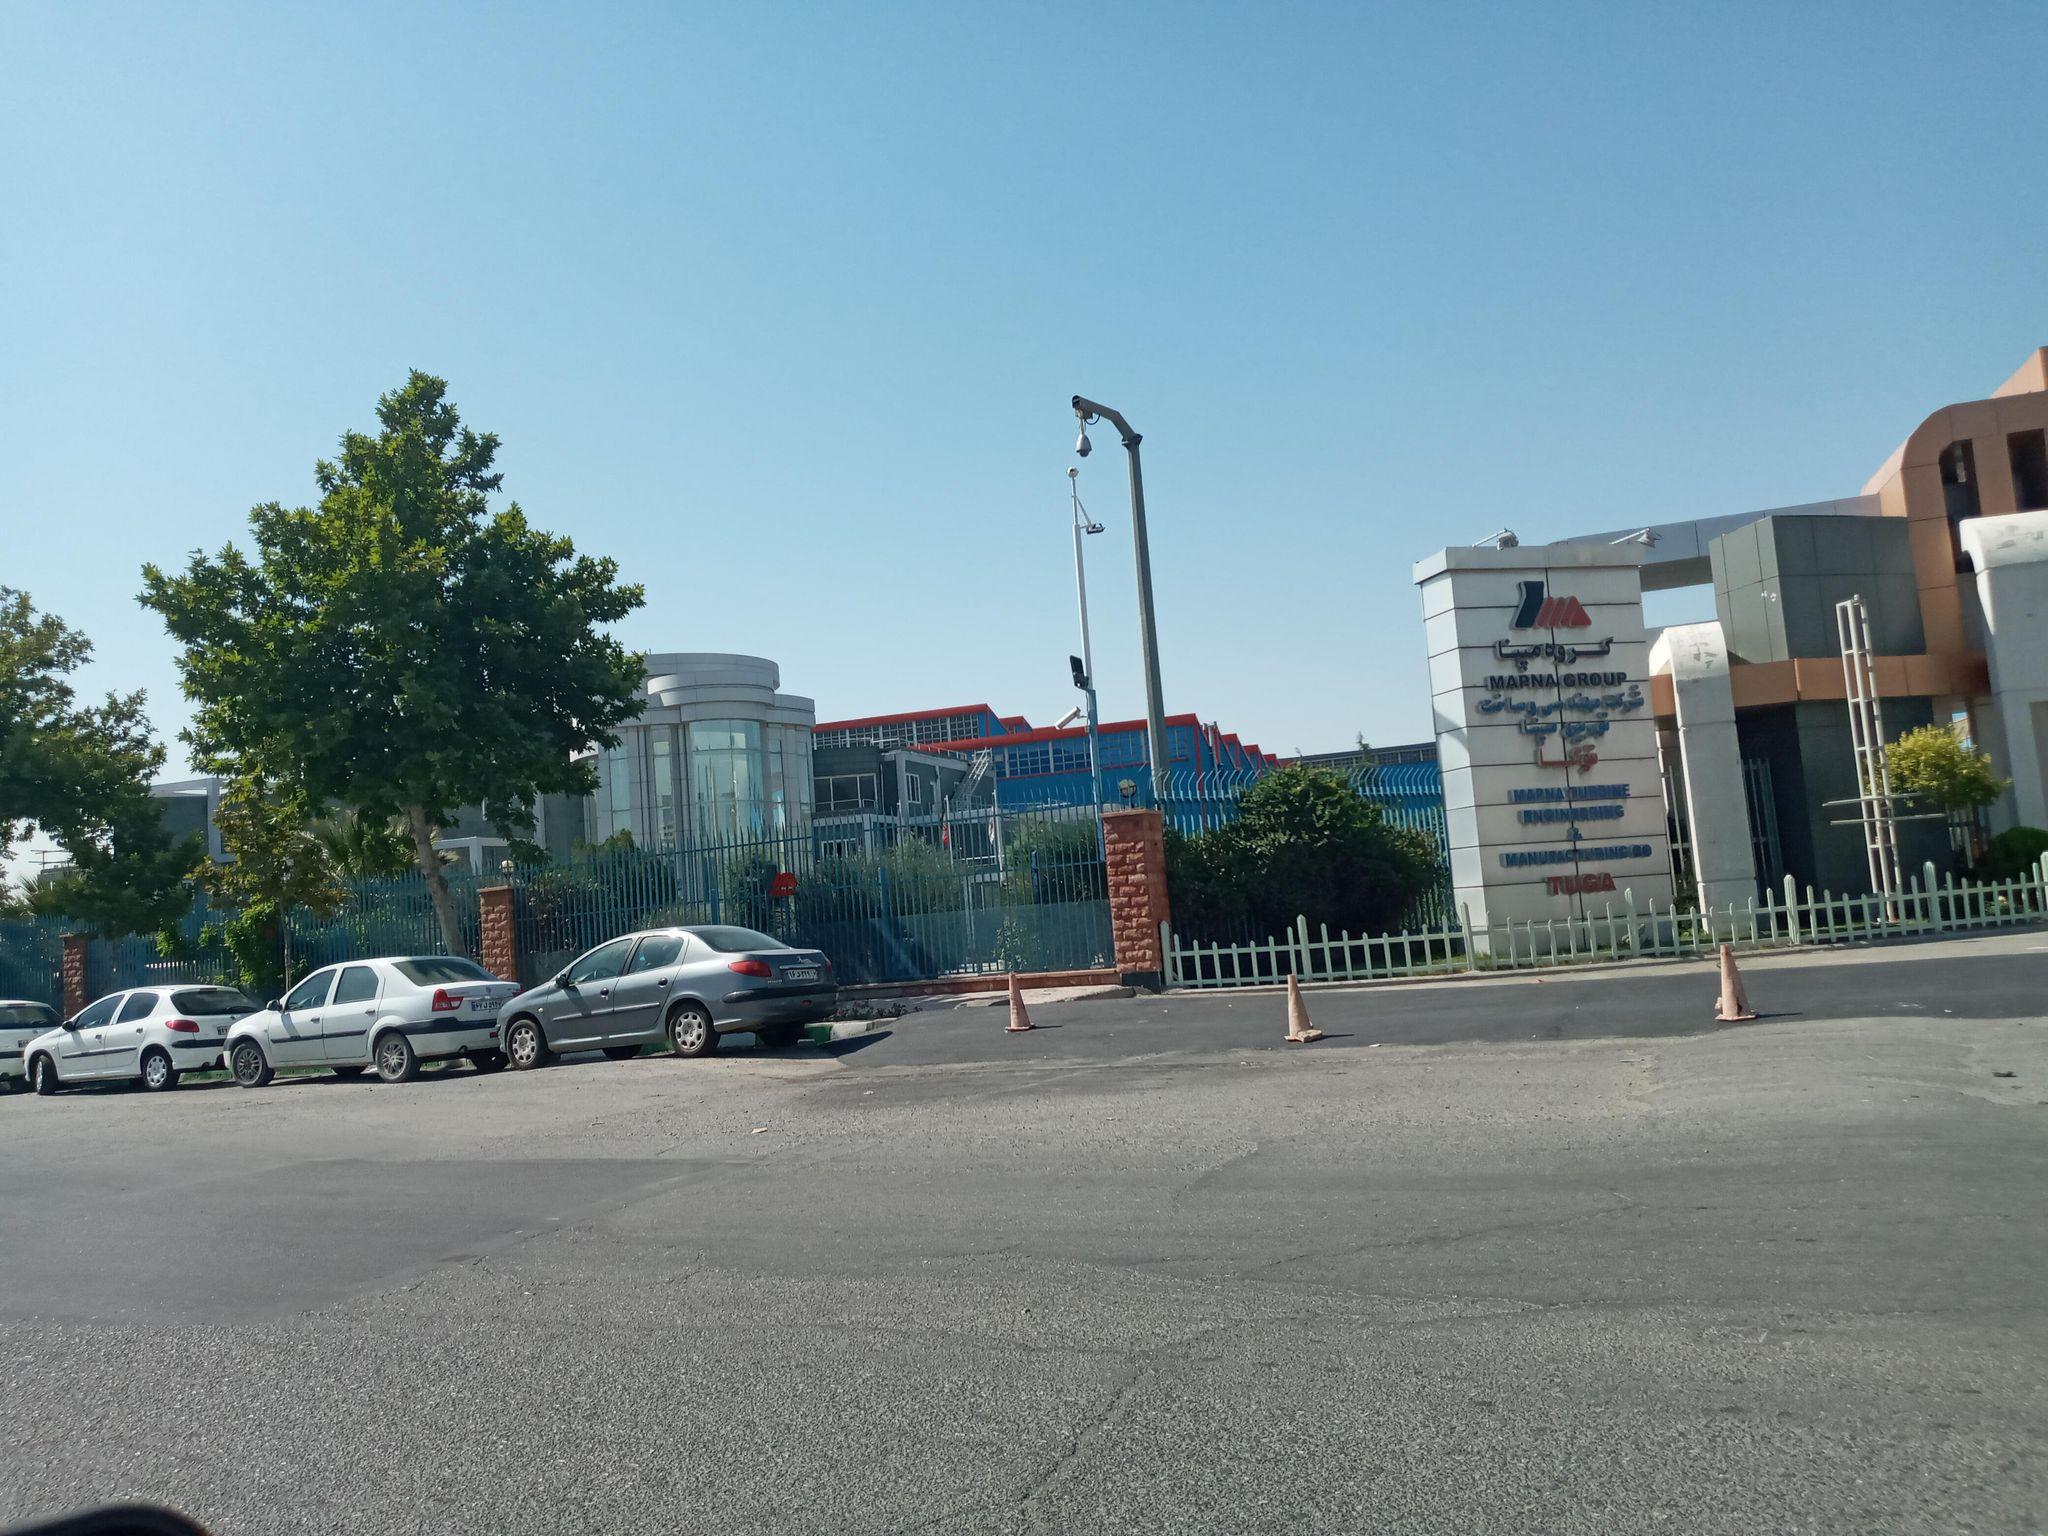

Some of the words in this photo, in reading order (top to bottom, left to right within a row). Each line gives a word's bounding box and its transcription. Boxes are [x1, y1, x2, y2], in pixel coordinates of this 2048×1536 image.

[1495, 638, 1543, 673] مپنا
[1486, 673, 1558, 690] MAPNA
[1562, 672, 1627, 688] GROUP
[1508, 787, 1565, 803] MAPNA
[1518, 805, 1625, 825] ENGINEERING
[1567, 827, 1583, 842] &
[1500, 845, 1629, 868] MANUFACTURING
[1546, 872, 1617, 896] TUGA
